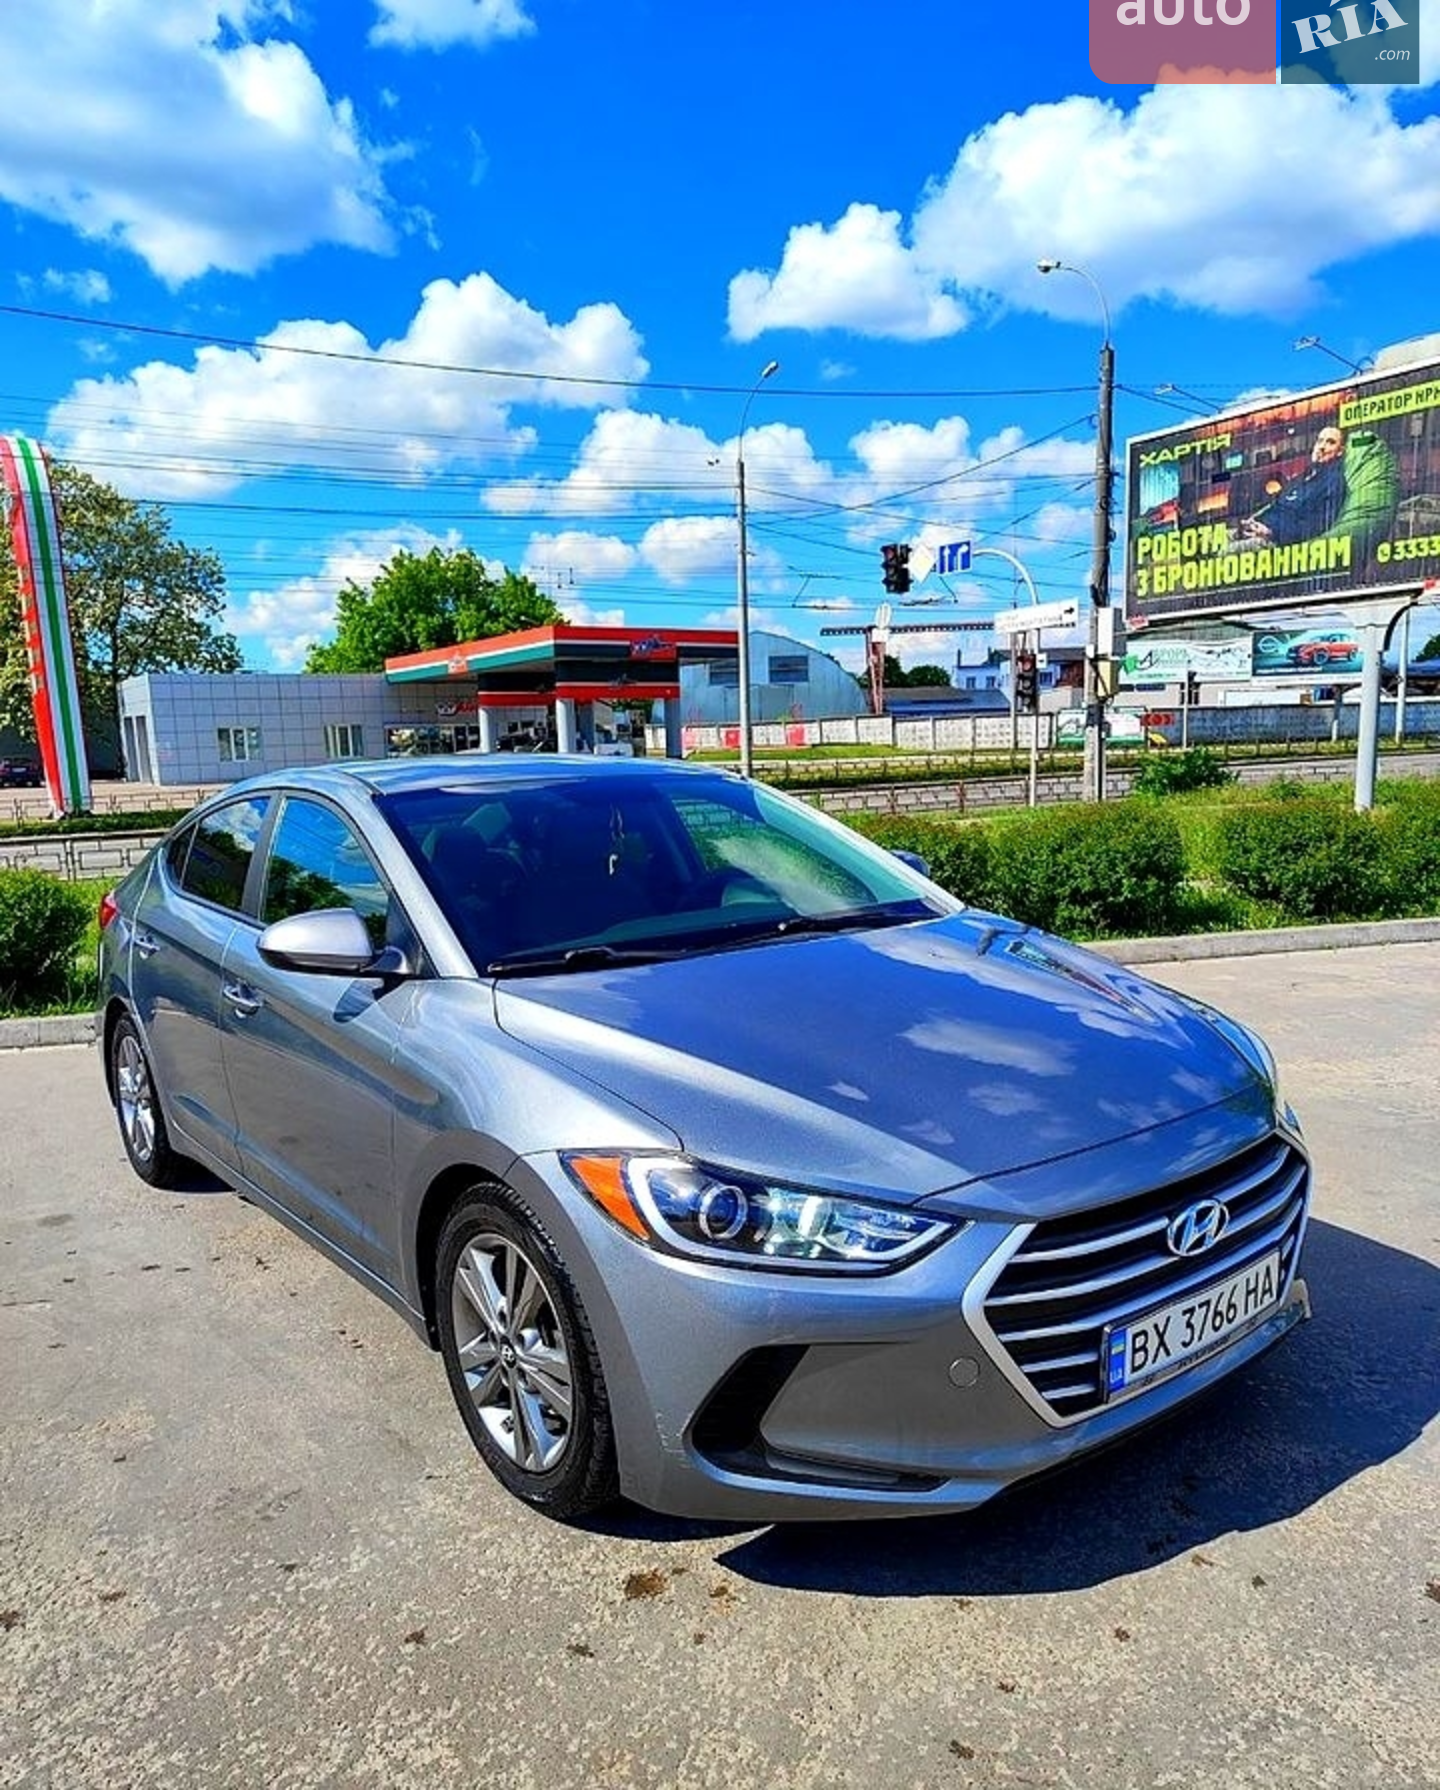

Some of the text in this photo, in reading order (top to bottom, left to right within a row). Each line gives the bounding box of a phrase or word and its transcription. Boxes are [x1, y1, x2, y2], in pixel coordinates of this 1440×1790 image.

[1345, 393, 1413, 421] ОПЕРАТОР
[1139, 432, 1232, 468] ХАРТІЯ
[1137, 522, 1229, 565] РОБОТА
[1152, 535, 1351, 595] БРОНЮВАННЯМ
[1131, 1315, 1172, 1375] BX
[1180, 1283, 1238, 1350] 3766
[1243, 1264, 1275, 1316] HA
